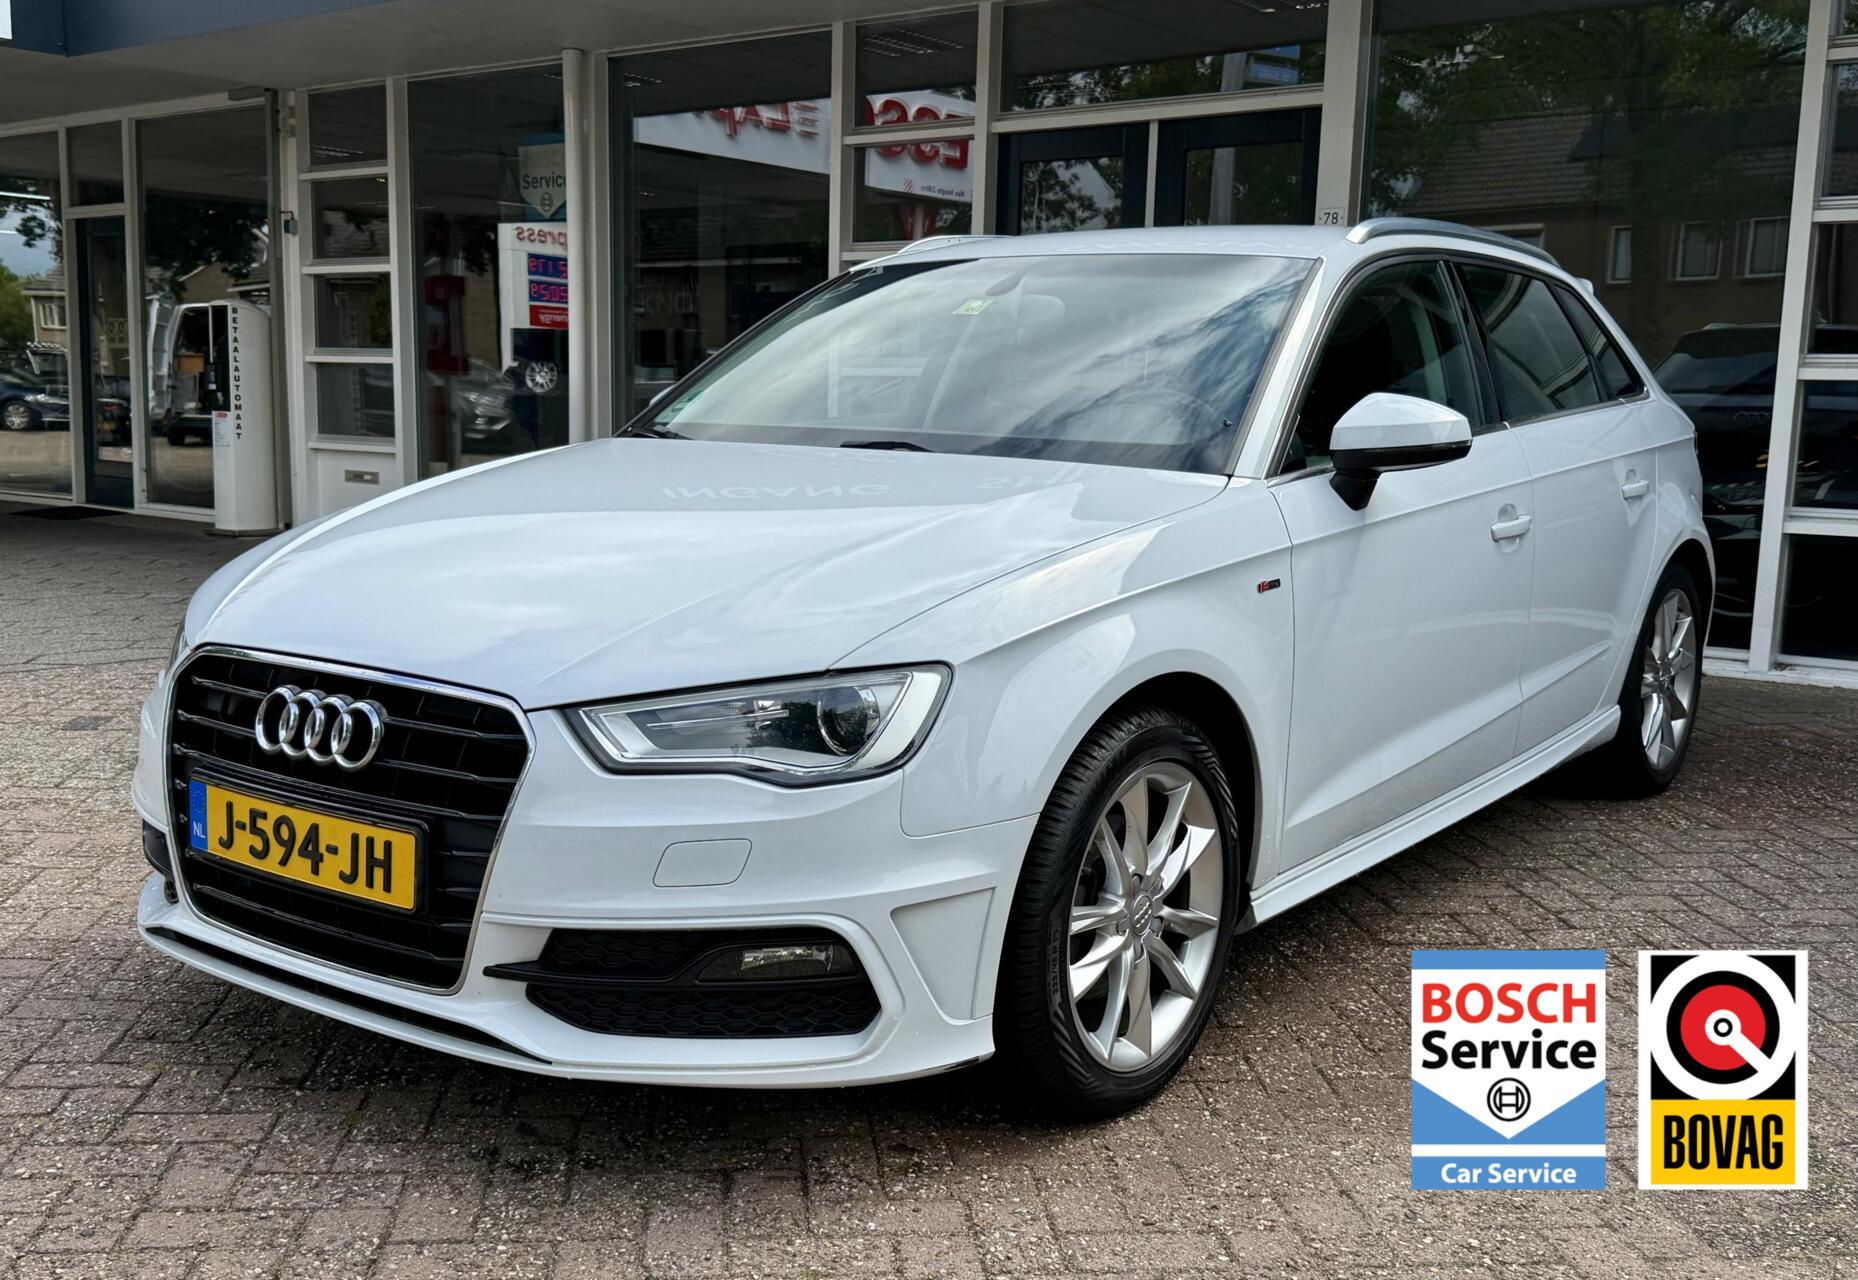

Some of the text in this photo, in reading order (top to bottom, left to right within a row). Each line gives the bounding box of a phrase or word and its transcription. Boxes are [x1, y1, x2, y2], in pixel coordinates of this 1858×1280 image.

[1323, 211, 1339, 225] 78
[231, 306, 242, 440] BETAALAUTOMAAT
[193, 820, 206, 839] NL
[218, 800, 393, 894] J-594-JH
